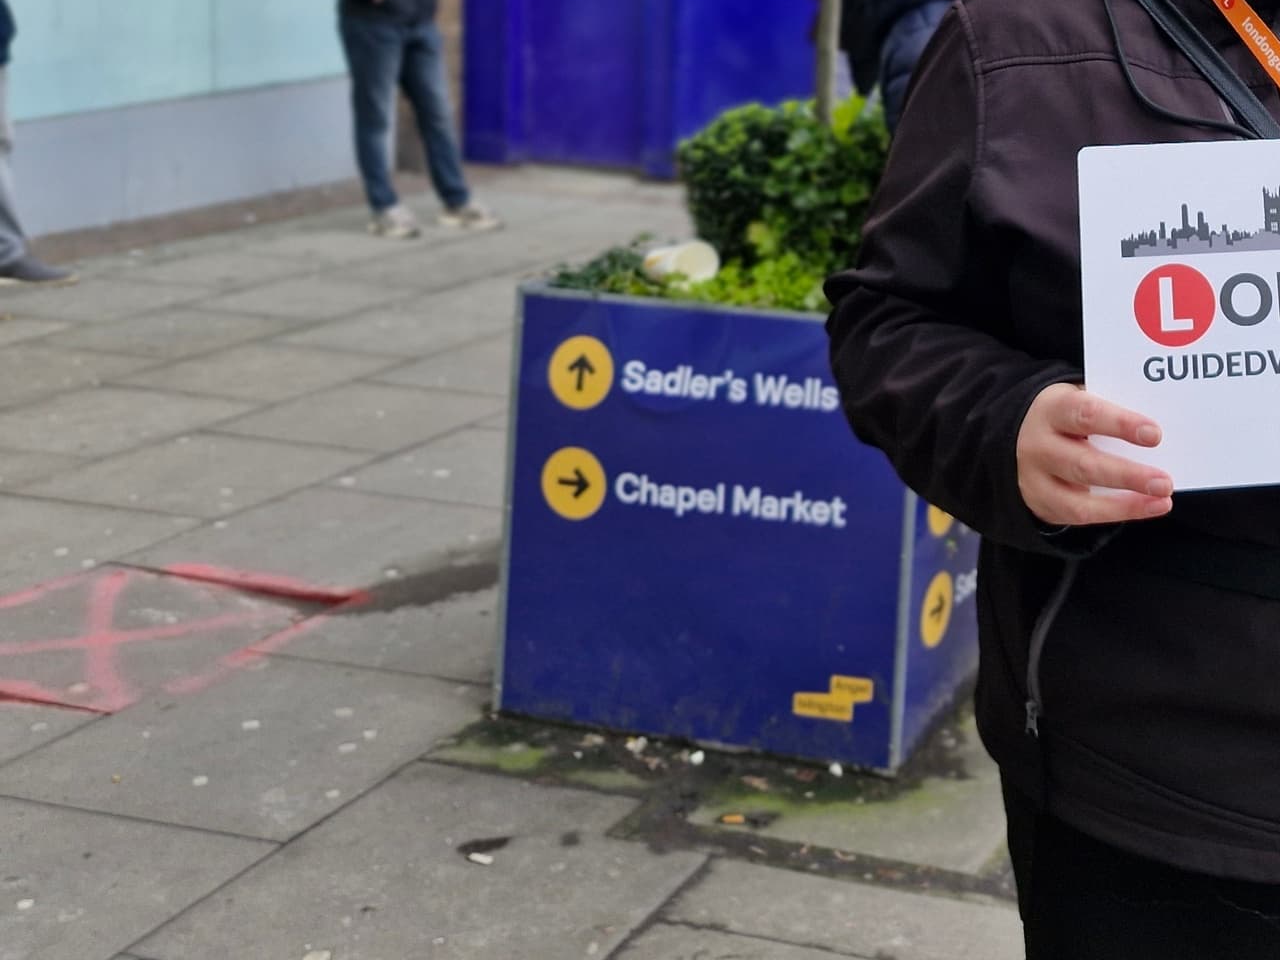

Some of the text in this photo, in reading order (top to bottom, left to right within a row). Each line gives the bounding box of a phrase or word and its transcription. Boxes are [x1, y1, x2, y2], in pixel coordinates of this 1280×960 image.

[621, 360, 840, 411] Sadler's Wells
[615, 472, 848, 528] Chapel Market
